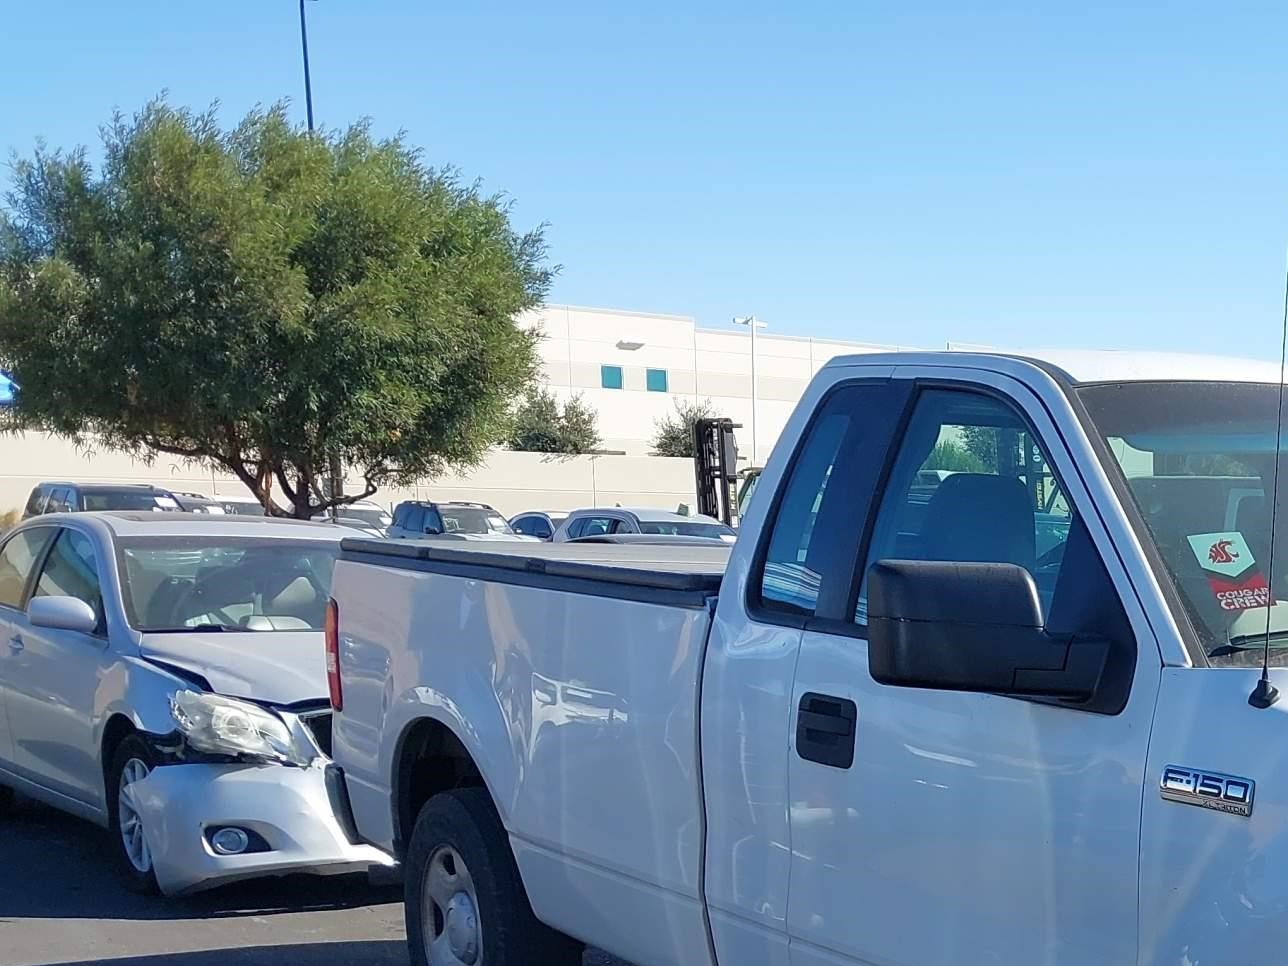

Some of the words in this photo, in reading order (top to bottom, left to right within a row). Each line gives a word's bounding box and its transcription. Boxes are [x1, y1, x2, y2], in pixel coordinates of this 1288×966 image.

[1216, 587, 1269, 600] COUGAR
[1220, 594, 1270, 610] CREW
[1161, 767, 1250, 803] F-150
